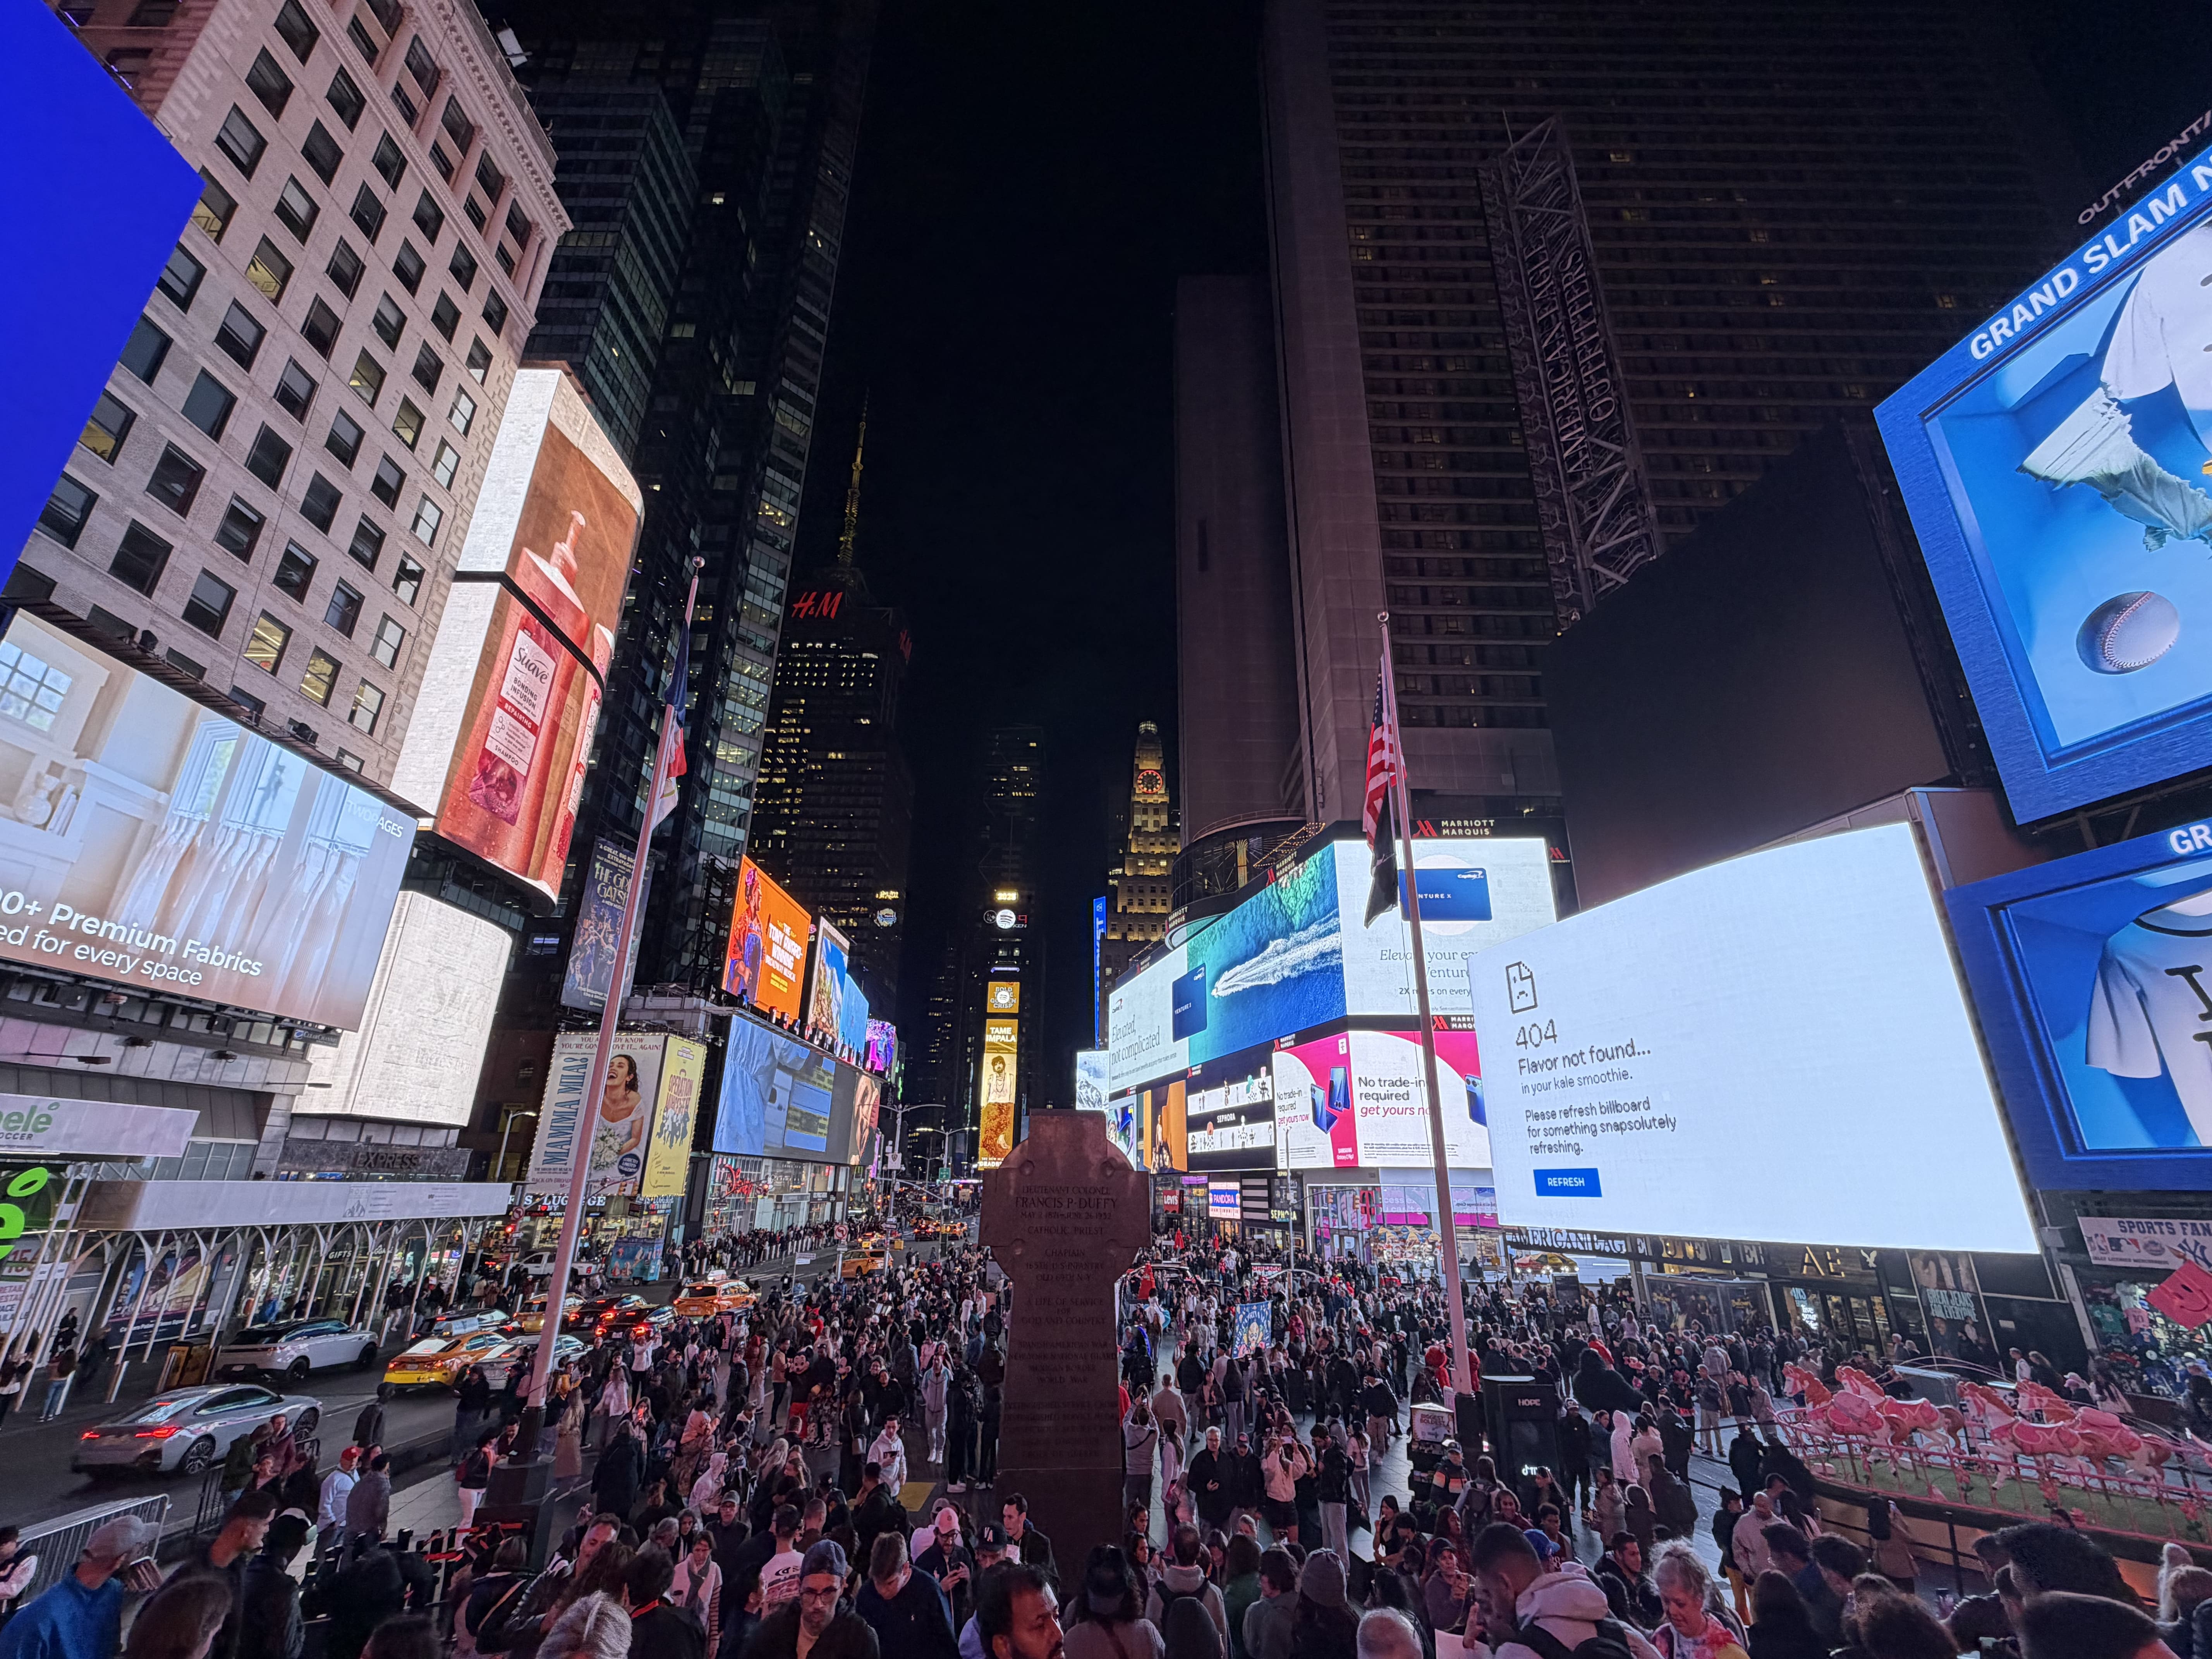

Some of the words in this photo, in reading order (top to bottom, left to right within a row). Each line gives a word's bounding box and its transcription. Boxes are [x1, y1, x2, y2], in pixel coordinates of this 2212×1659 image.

[1970, 268, 2078, 359] GRAND
[2083, 184, 2187, 273] SLAM
[792, 591, 843, 620] H&M
[514, 647, 549, 684] Suave
[510, 684, 536, 710] INFUSION
[514, 677, 538, 701] BONDING
[505, 703, 532, 729] REPAIRING
[495, 745, 519, 766] SHAMPOO
[344, 799, 404, 838] TWOPAGES
[1276, 852, 1297, 870] MARRIOTT
[597, 883, 628, 906] GATS
[1168, 907, 1188, 922] MARRIOTT
[0, 888, 43, 917] 0+
[48, 902, 178, 955] Premium
[182, 938, 263, 977] Fabrics
[769, 923, 784, 946] TONY
[32, 930, 71, 957] for
[74, 945, 140, 975] every
[141, 956, 203, 986] space
[1380, 950, 1412, 960] Eleva
[1428, 952, 1458, 963] your
[986, 1034, 1016, 1043] IMPALA
[989, 1027, 1012, 1035] TAME
[1112, 1014, 1136, 1043] Elevated,
[1516, 1019, 1557, 1050] 404
[1111, 1049, 1121, 1065] not
[1122, 1025, 1160, 1060] complicated
[1518, 1055, 1559, 1075] Flavor
[1563, 1049, 1587, 1068] not
[1589, 1038, 1651, 1064] found...
[558, 1057, 589, 1096] MIA!
[1359, 1077, 1375, 1087] No
[1377, 1077, 1425, 1087] trade-in
[1521, 1083, 1529, 1094] in
[1531, 1081, 1551, 1096] your
[1554, 1075, 1575, 1090] kale
[1577, 1068, 1633, 1086] smoothie.
[1278, 1100, 1297, 1112] required
[1360, 1091, 1409, 1104] required
[1217, 1113, 1235, 1123] SEPHORA
[1286, 1115, 1299, 1125] yours
[1299, 1113, 1309, 1122] now
[1360, 1106, 1380, 1117] get
[1382, 1106, 1415, 1118] yours
[1525, 1108, 1557, 1122] Please
[1559, 1103, 1597, 1119] refresh
[1599, 1096, 1650, 1114] billboard
[543, 1099, 580, 1166] MAMMA
[1527, 1125, 1541, 1138] for
[1544, 1121, 1598, 1137] something
[1600, 1114, 1676, 1135] snapsolutely
[1530, 1141, 1583, 1156] refreshing.
[356, 1152, 419, 1169] EXPRESS
[1023, 1186, 1069, 1194] LIEUTENANT
[1072, 1186, 1110, 1195] COLONEL
[1547, 1177, 1585, 1187] REFRESH
[543, 1195, 606, 1206] LUGGE
[1015, 1197, 1063, 1208] FRANCIS
[1079, 1198, 1117, 1209] DUFFY
[1027, 1226, 1070, 1235] CATHOLIC
[1074, 1226, 1103, 1235] PRIEST
[2118, 1220, 2176, 1235] SPORTS
[328, 1250, 352, 1259] GIFTS
[1045, 1249, 1085, 1257] CHAPLAIN
[1801, 1245, 1845, 1278] AE
[1927, 1288, 1949, 1305] GREAT
[1949, 1291, 1975, 1309] JEANS
